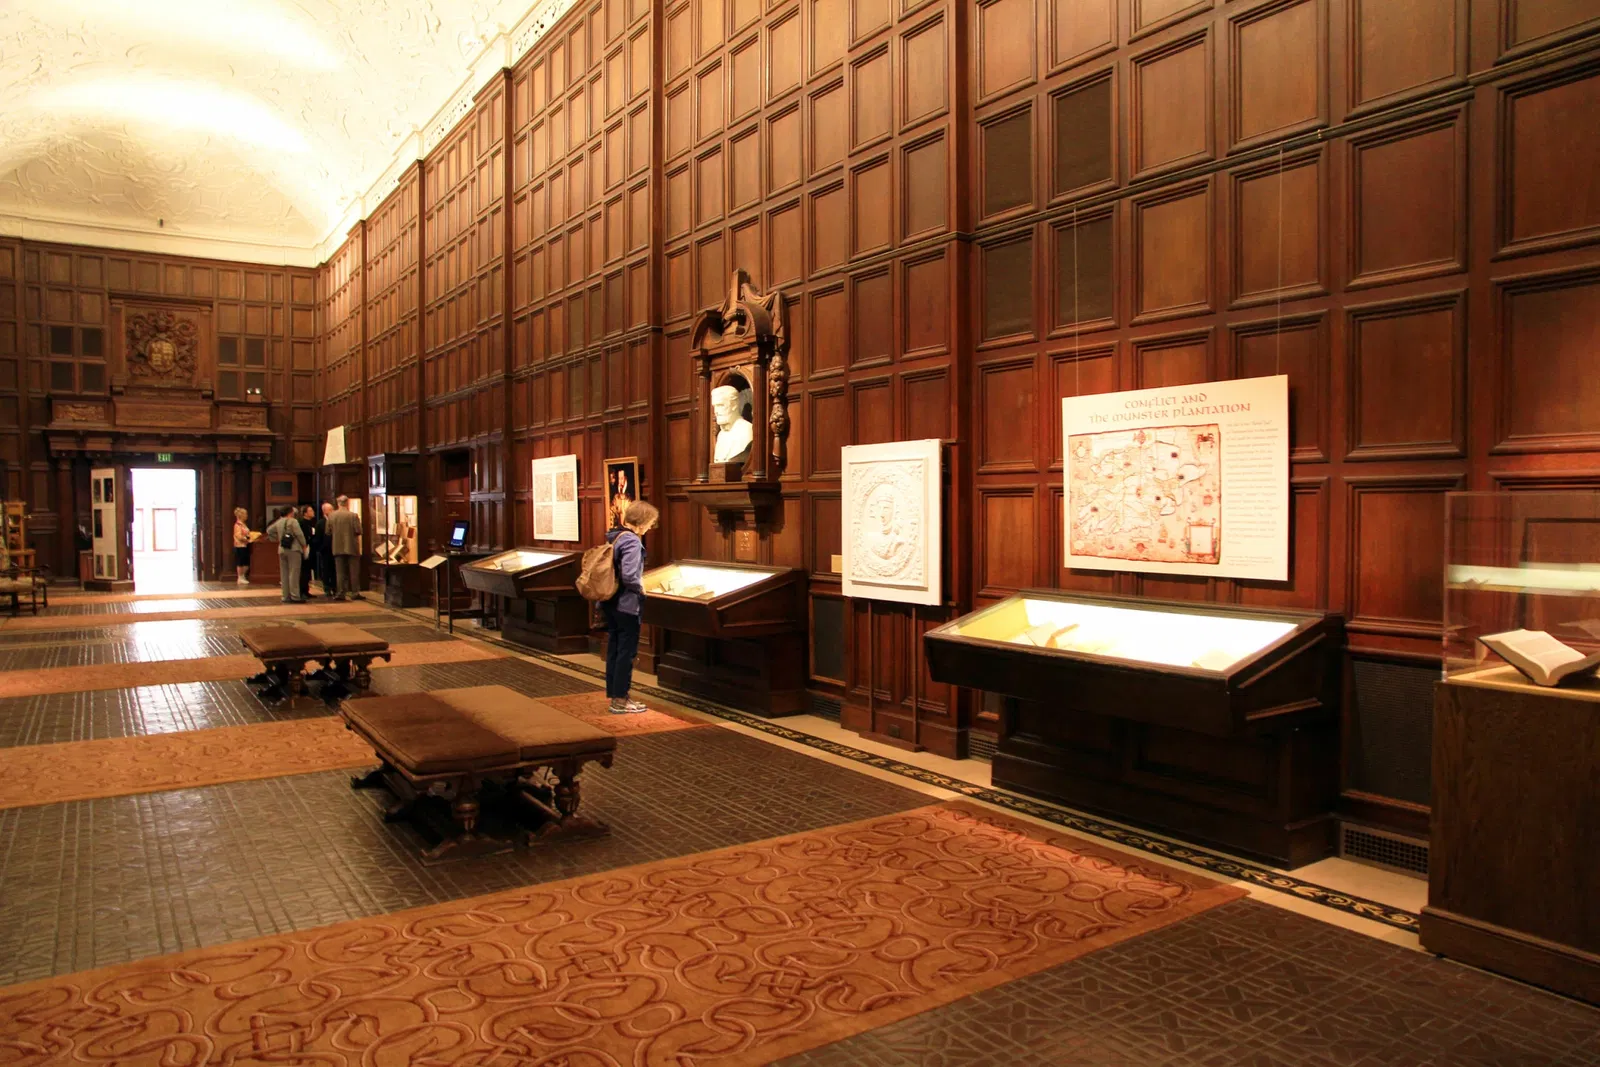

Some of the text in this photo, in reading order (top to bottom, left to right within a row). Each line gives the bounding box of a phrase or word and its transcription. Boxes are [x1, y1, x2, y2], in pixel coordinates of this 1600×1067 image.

[1124, 392, 1208, 409] CONFLICT AND
[1112, 409, 1169, 422] MUNSTER
[1172, 402, 1252, 419] PLANTATION
[157, 453, 171, 463] EXIT
